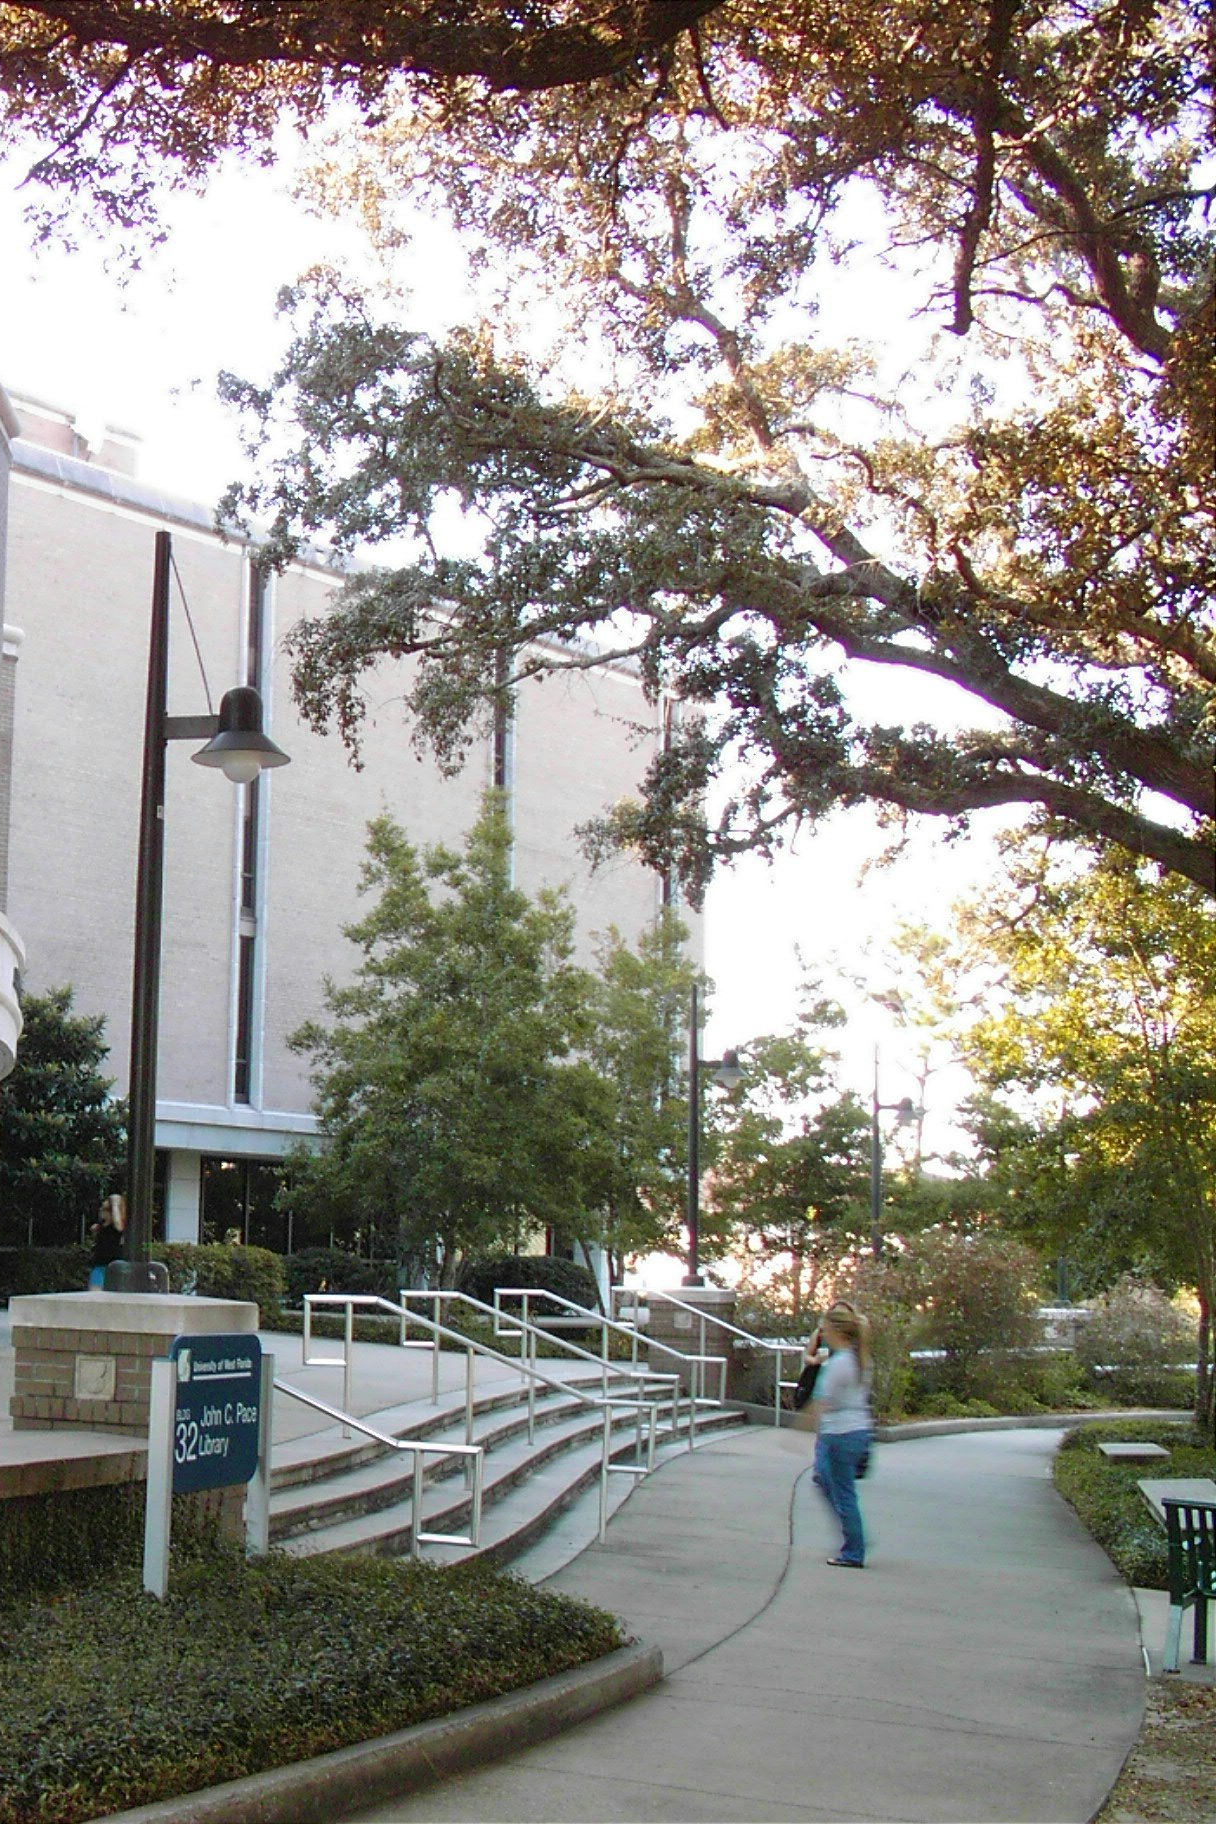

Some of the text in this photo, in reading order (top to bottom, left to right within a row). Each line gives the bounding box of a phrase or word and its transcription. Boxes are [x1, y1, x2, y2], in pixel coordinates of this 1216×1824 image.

[193, 1356, 252, 1374] University of West Florida
[200, 1405, 222, 1427] John
[236, 1402, 257, 1423] Pace
[175, 1421, 198, 1464] 32
[198, 1433, 229, 1458] Library
